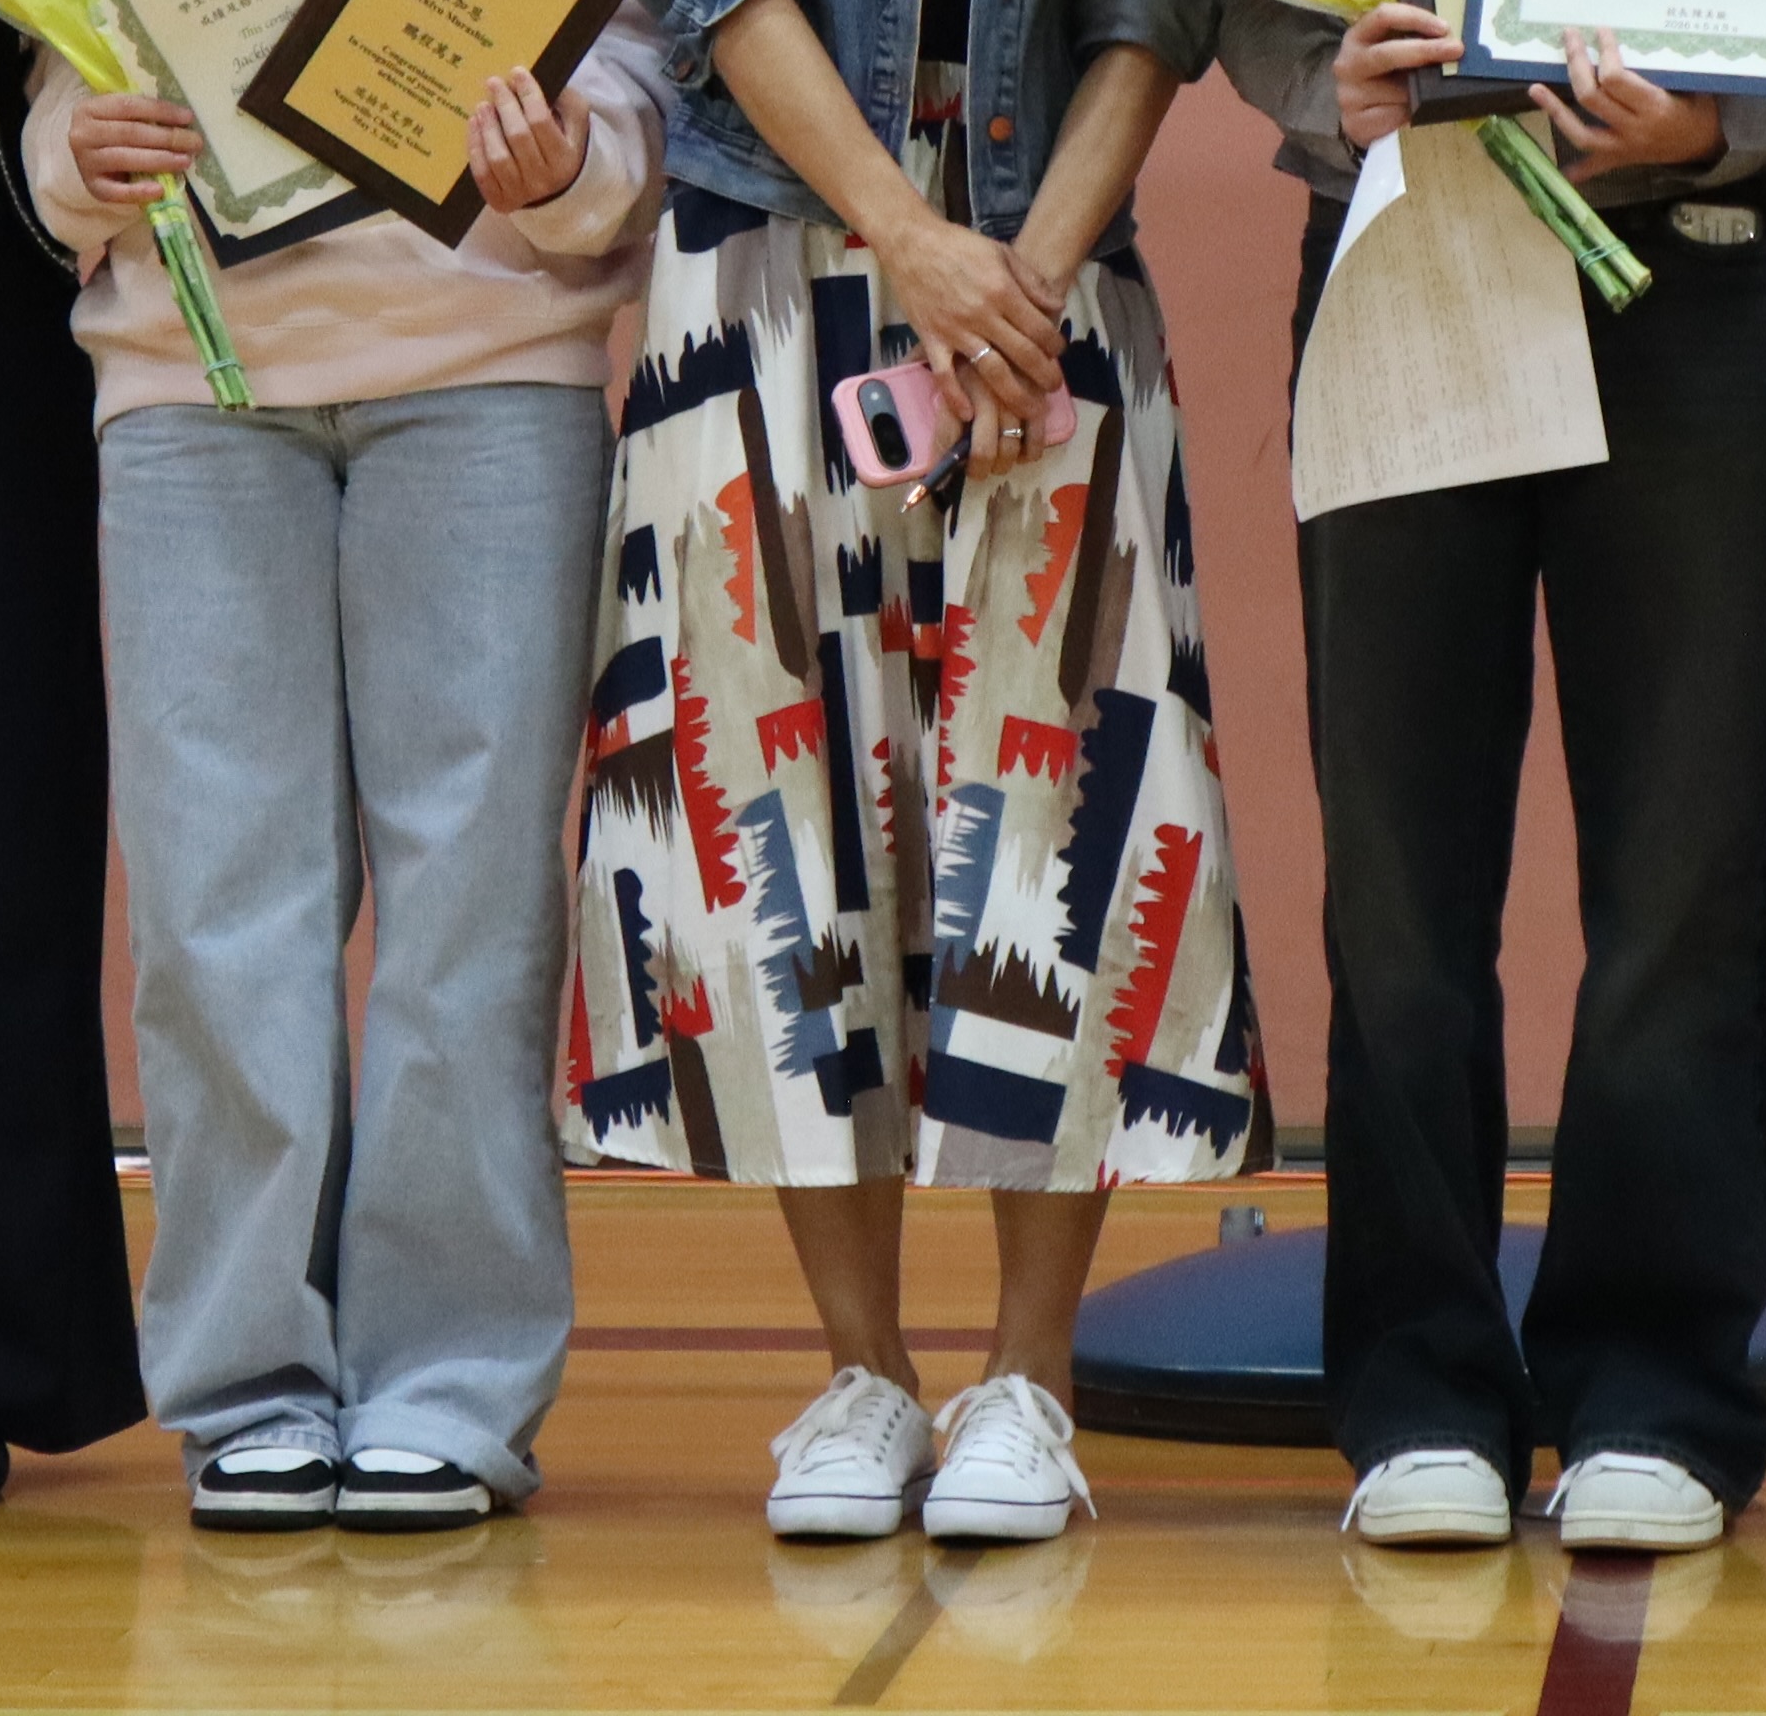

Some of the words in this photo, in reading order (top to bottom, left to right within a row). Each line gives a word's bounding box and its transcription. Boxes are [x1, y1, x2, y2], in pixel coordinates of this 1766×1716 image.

[241, 25, 263, 40] This
[348, 35, 359, 46] In
[406, 74, 418, 86] of
[415, 82, 436, 98] your
[353, 115, 369, 132] May
